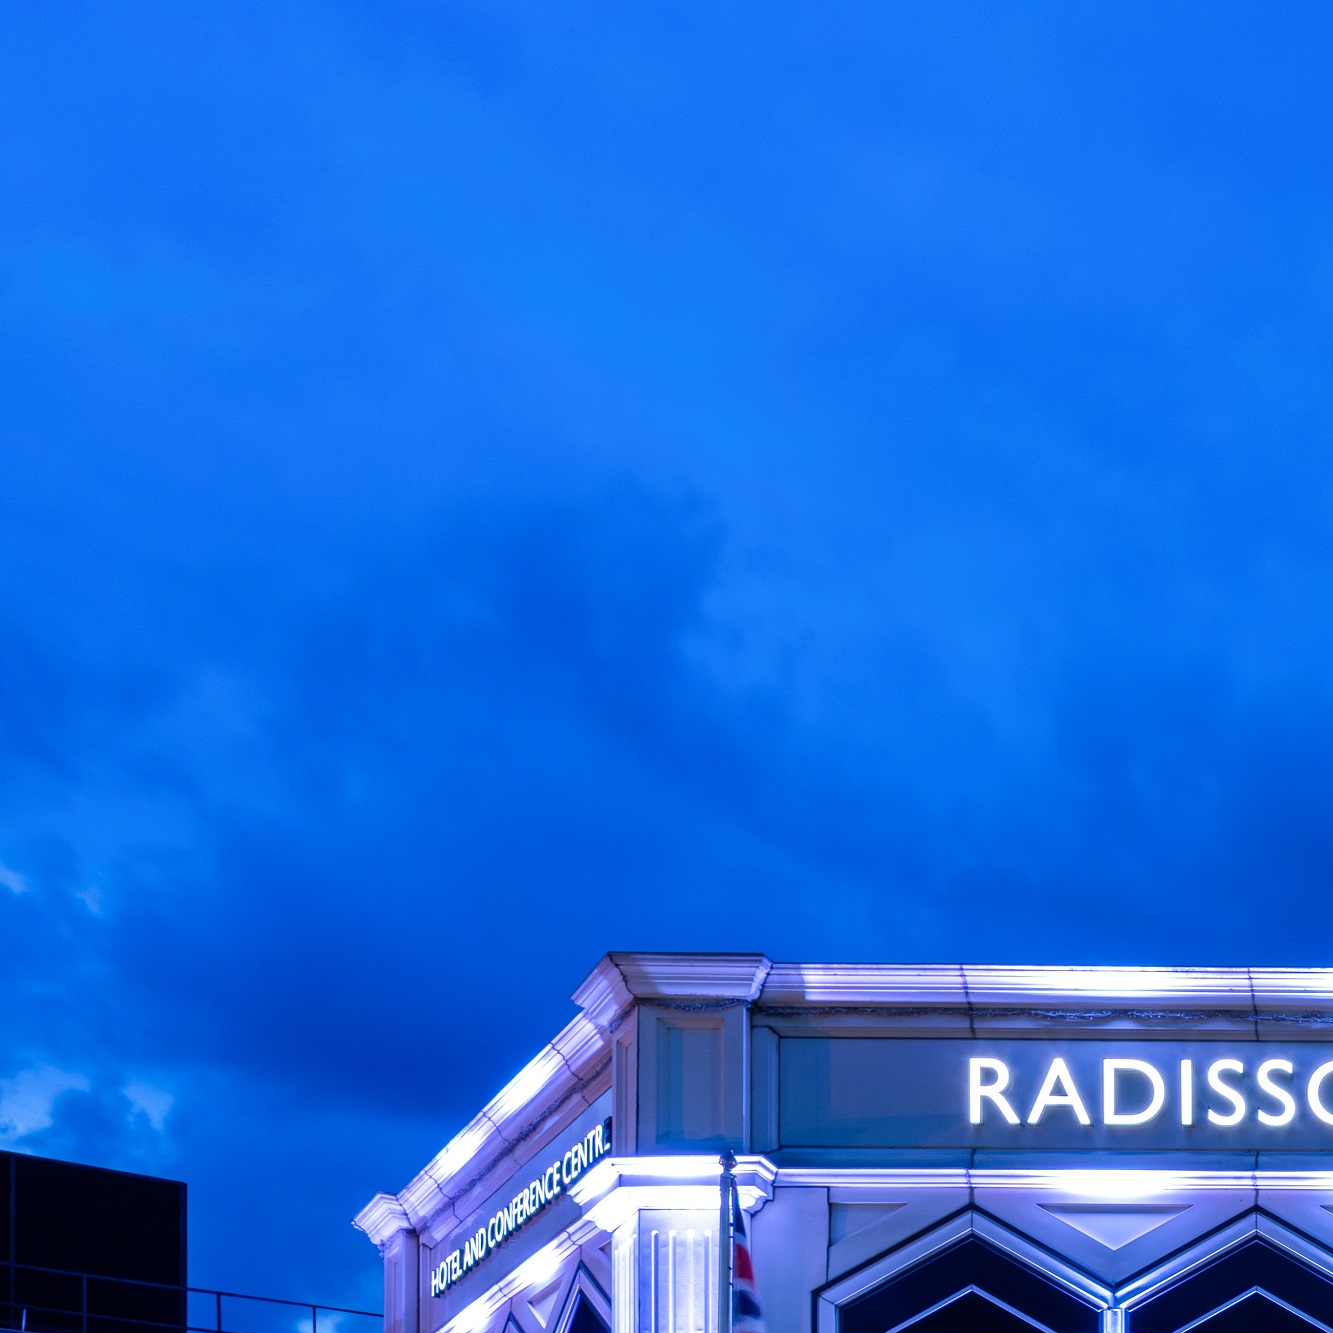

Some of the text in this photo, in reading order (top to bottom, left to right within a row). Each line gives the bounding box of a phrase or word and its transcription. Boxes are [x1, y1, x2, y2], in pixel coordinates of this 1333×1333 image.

[431, 1249, 462, 1297] HOTEL
[463, 1227, 487, 1271] AND
[487, 1160, 561, 1248] CONFERENCE
